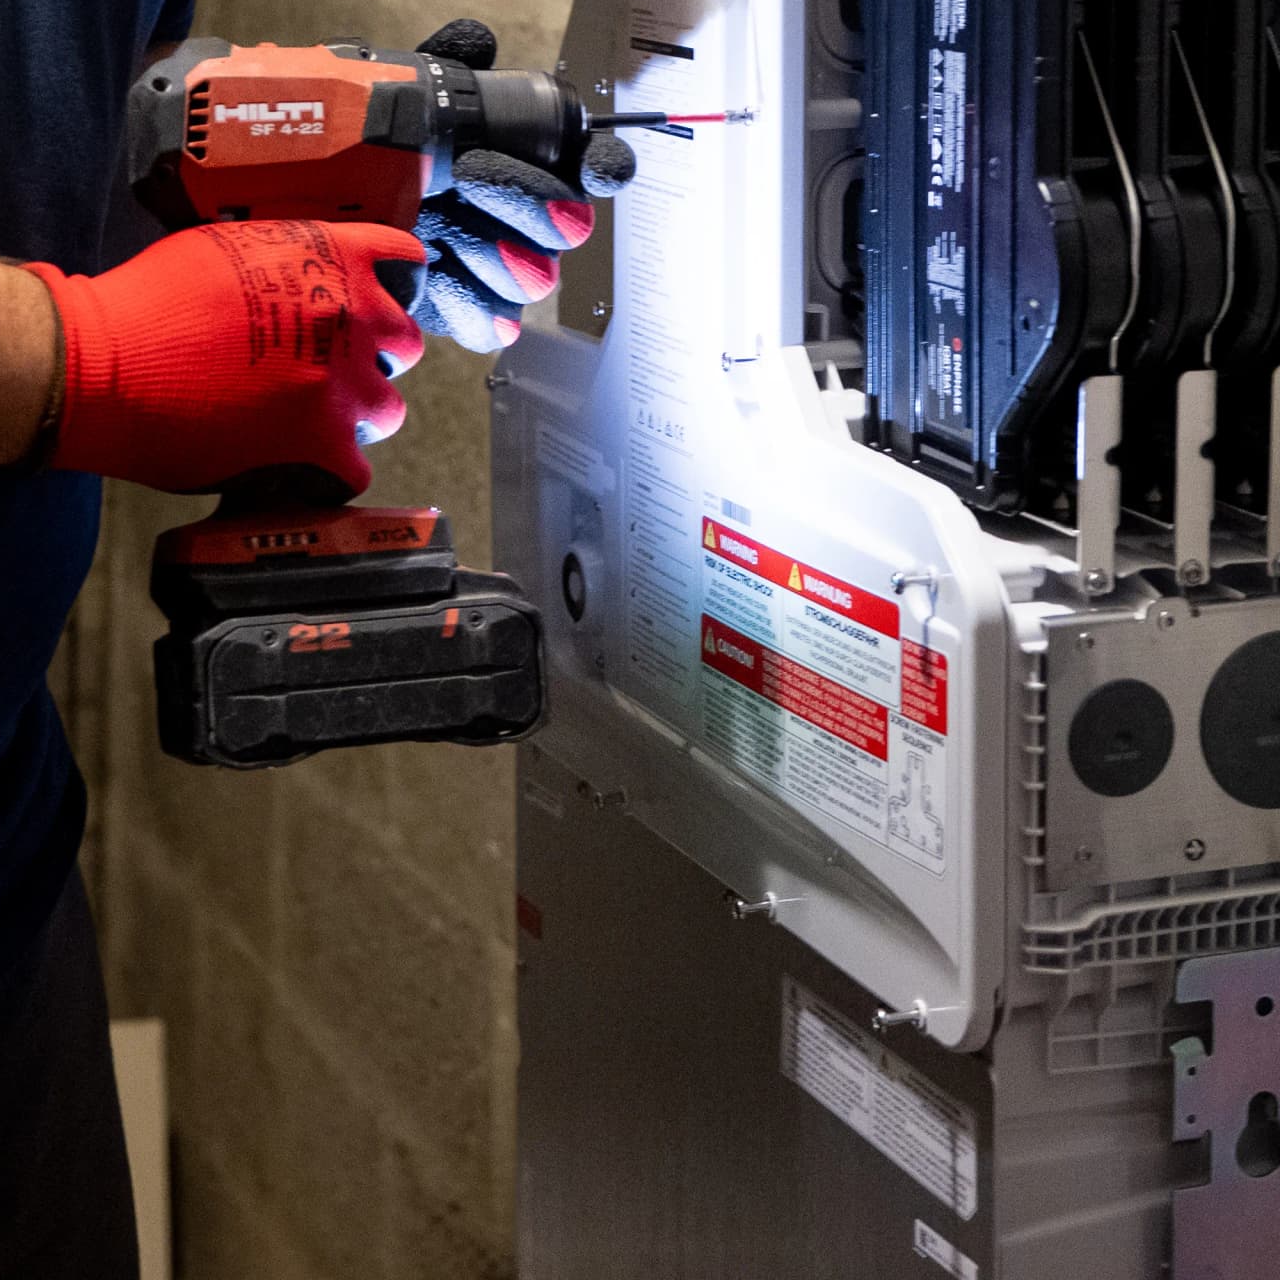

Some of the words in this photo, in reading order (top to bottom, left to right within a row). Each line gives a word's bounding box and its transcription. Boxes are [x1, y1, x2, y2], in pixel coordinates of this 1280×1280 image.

[214, 101, 324, 123] HILTI
[250, 123, 276, 136] SF
[280, 122, 324, 136] 4-22
[719, 533, 759, 565] WARNING
[802, 573, 853, 609] WARNUNG
[288, 622, 352, 653] 22
